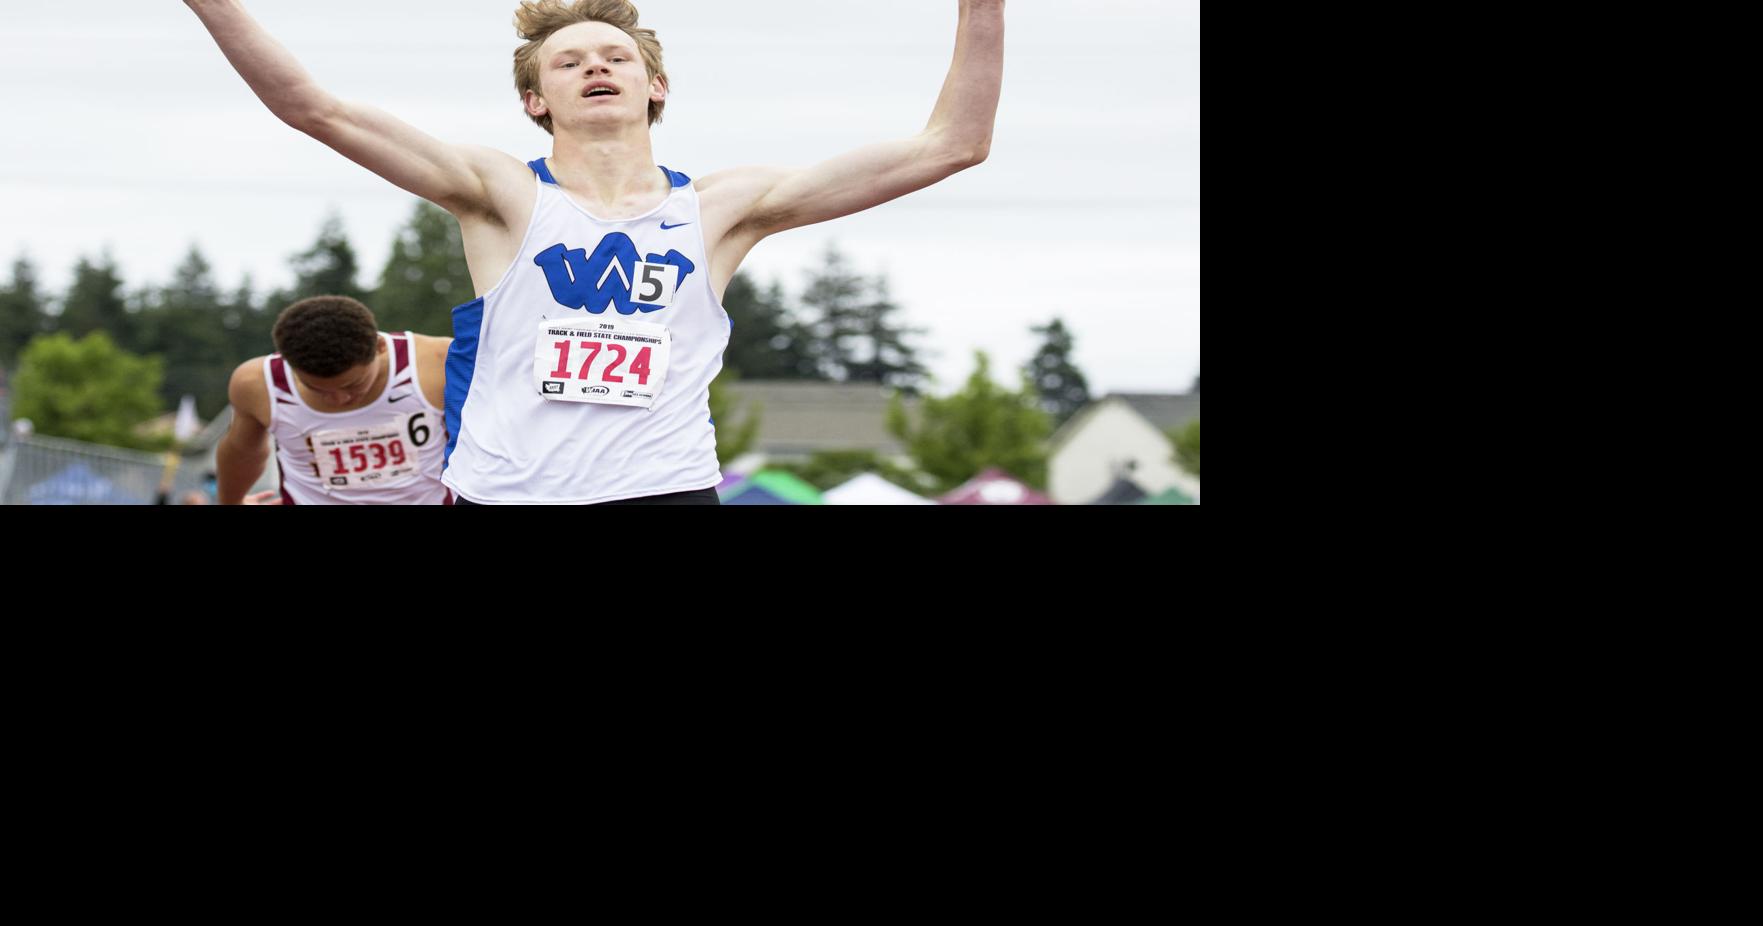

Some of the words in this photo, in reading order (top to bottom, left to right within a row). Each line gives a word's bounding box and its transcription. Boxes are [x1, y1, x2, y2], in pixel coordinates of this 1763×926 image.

[638, 265, 665, 302] 5
[593, 332, 612, 340] STATE
[613, 334, 662, 345] CHAMPIONSHIPS
[550, 340, 652, 385] 1724
[408, 412, 430, 447] 6
[329, 440, 406, 475] 1539
